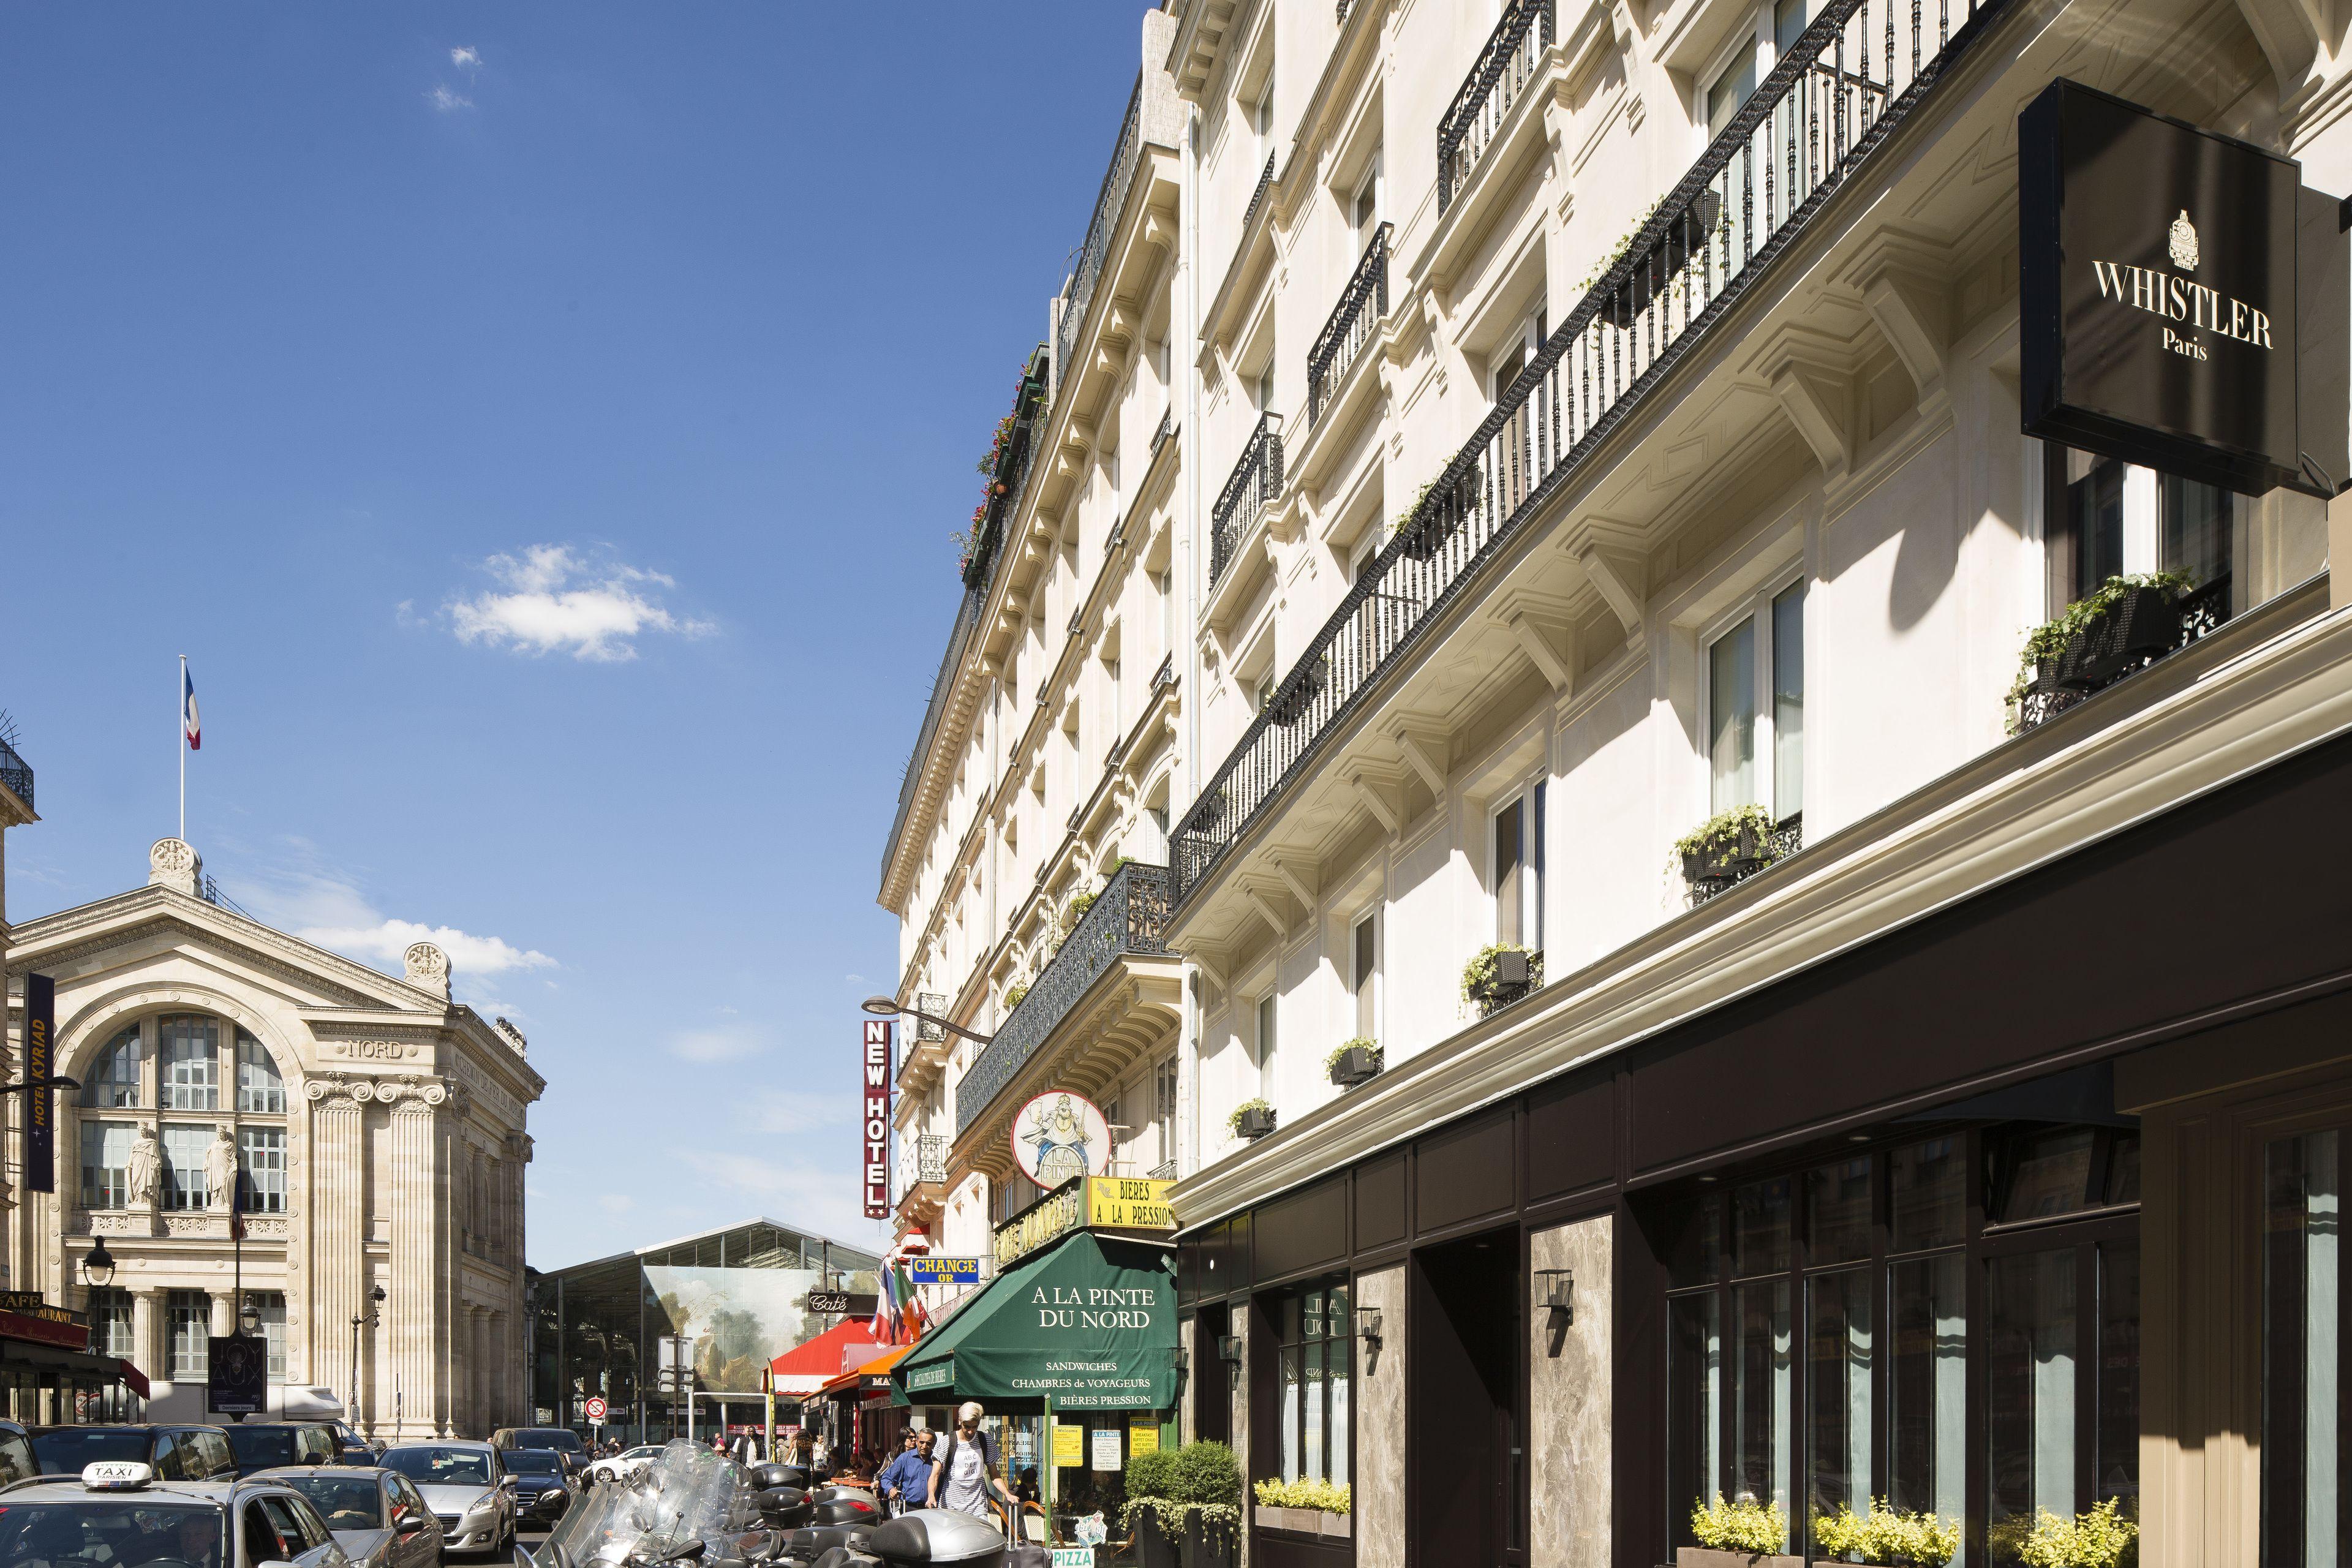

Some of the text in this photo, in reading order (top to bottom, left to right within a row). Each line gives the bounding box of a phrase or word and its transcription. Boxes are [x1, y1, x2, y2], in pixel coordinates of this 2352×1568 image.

[2092, 261, 2274, 350] WHISTLER
[2162, 328, 2207, 361] Paris
[32, 1019, 45, 1080] KYRIAD
[347, 1040, 402, 1060] NORD
[459, 1057, 480, 1085] CHEMIN
[481, 1074, 488, 1092] DE
[489, 1082, 499, 1102] FER
[501, 1091, 507, 1107] DU
[867, 1022, 886, 1206] NEW HOTEL
[1052, 1149, 1071, 1164] LA
[1043, 1164, 1083, 1180] PINTE
[1120, 1181, 1150, 1201] BIERES
[1096, 1204, 1102, 1223] A
[1112, 1205, 1123, 1224] LA
[1133, 1205, 1175, 1226] PRESSION
[914, 1259, 977, 1273] CHANGE
[938, 1273, 954, 1283] OR
[809, 1294, 847, 1312] Café
[1031, 1286, 1155, 1306] A LA PINTE
[1039, 1310, 1150, 1328] DU NORD
[211, 1343, 262, 1364] JOY
[210, 1365, 262, 1385] AUX
[1046, 1362, 1117, 1371] SANDWICHES
[1012, 1379, 1071, 1388] CHAMBRES
[1087, 1379, 1150, 1387] VOYAGEURS
[1060, 1394, 1151, 1405] BIÈRES PRESSION
[1054, 1551, 1091, 1566] PIZZA
